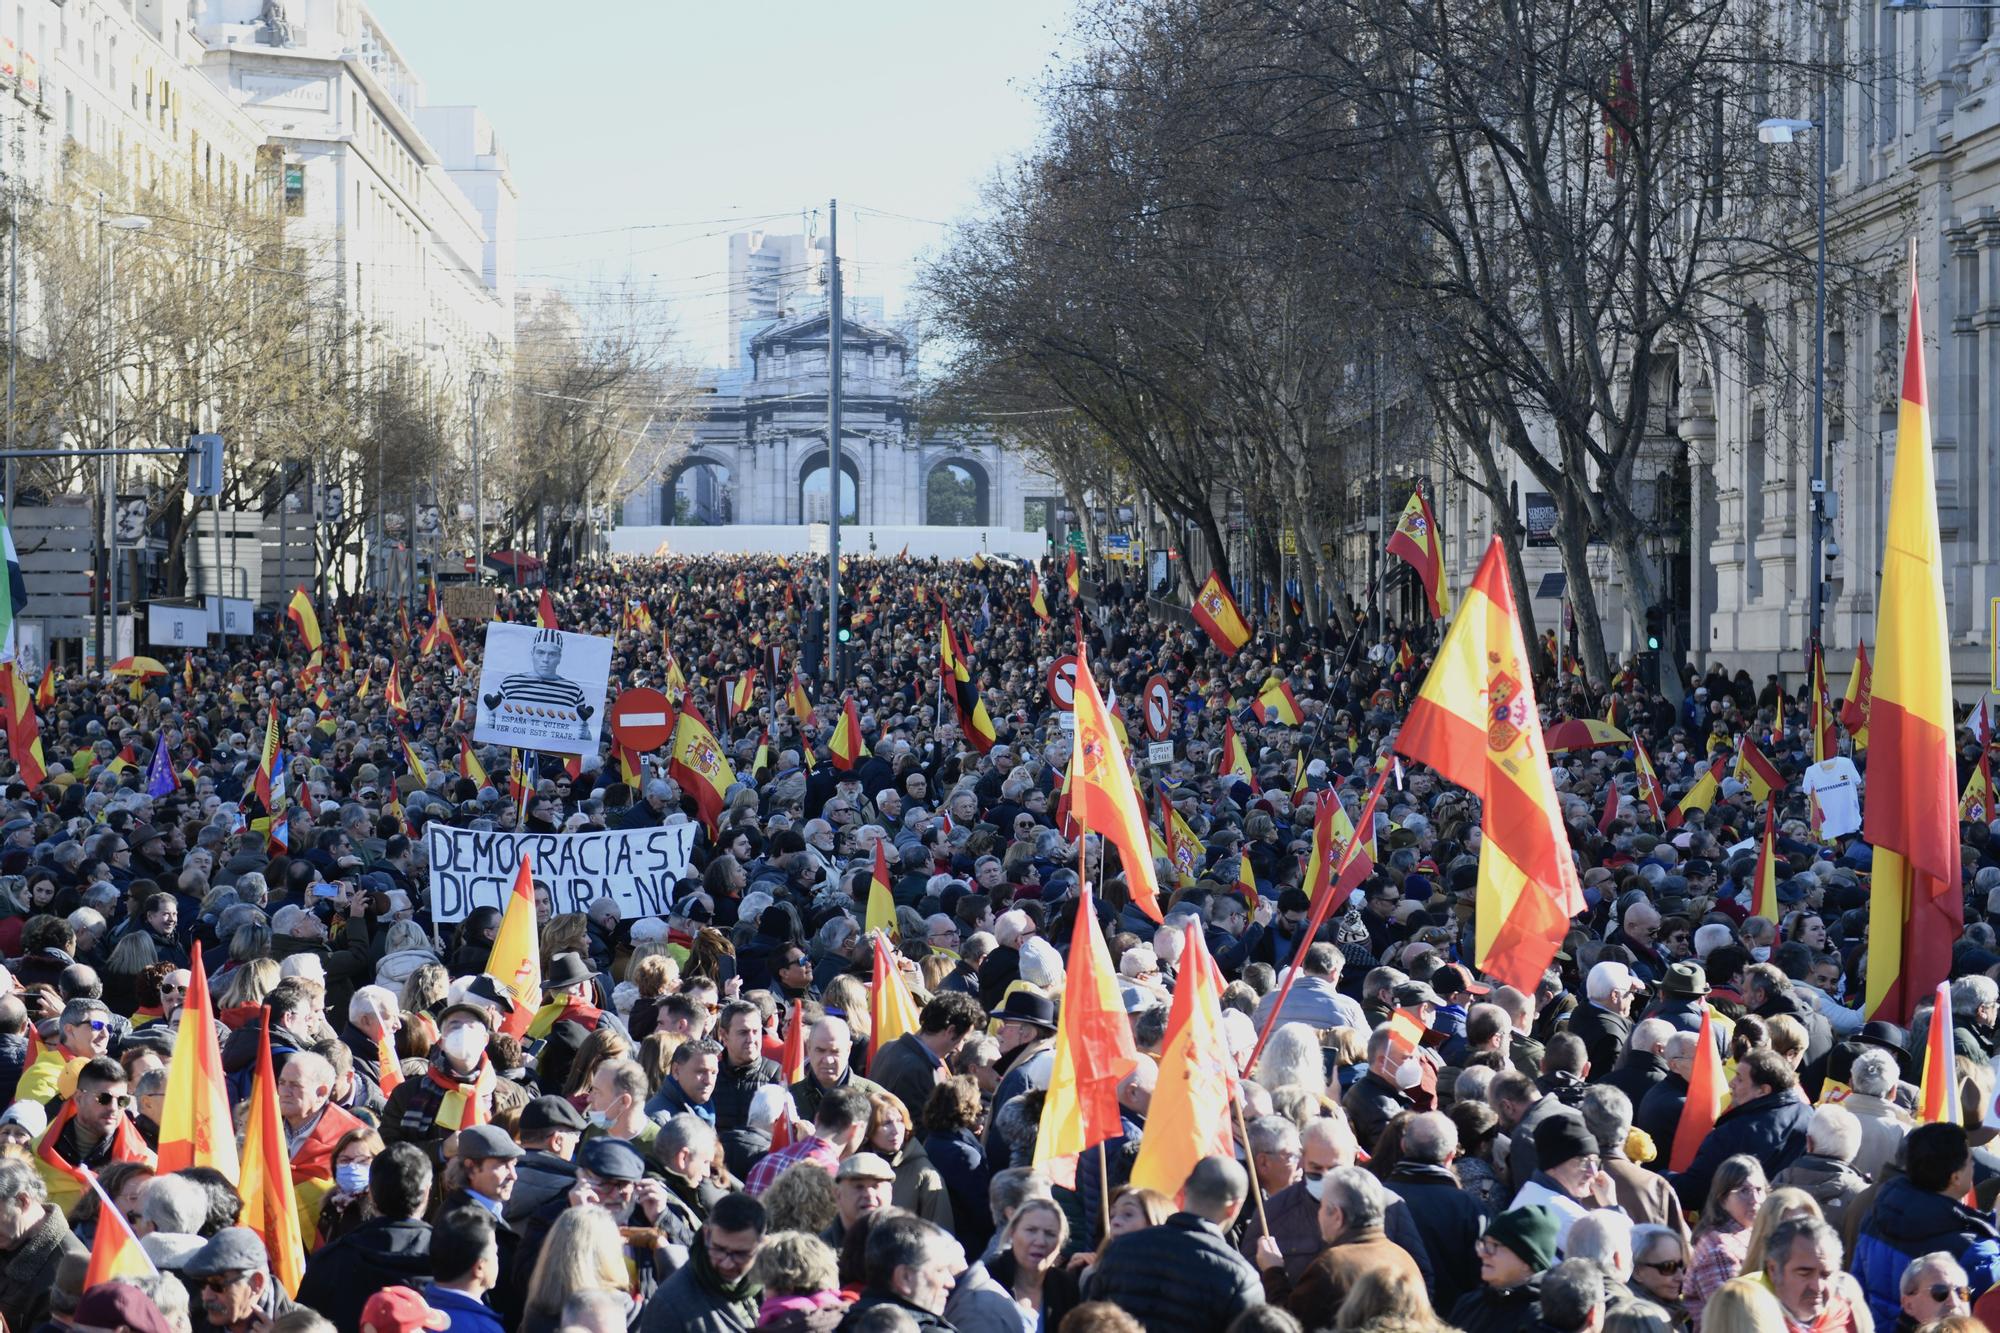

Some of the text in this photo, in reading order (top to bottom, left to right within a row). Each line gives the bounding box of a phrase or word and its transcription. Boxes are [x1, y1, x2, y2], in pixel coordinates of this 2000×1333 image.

[501, 715, 570, 730] ESPAÑA TE QUIERE
[496, 724, 576, 741] VER CON ESTE TRAJE.
